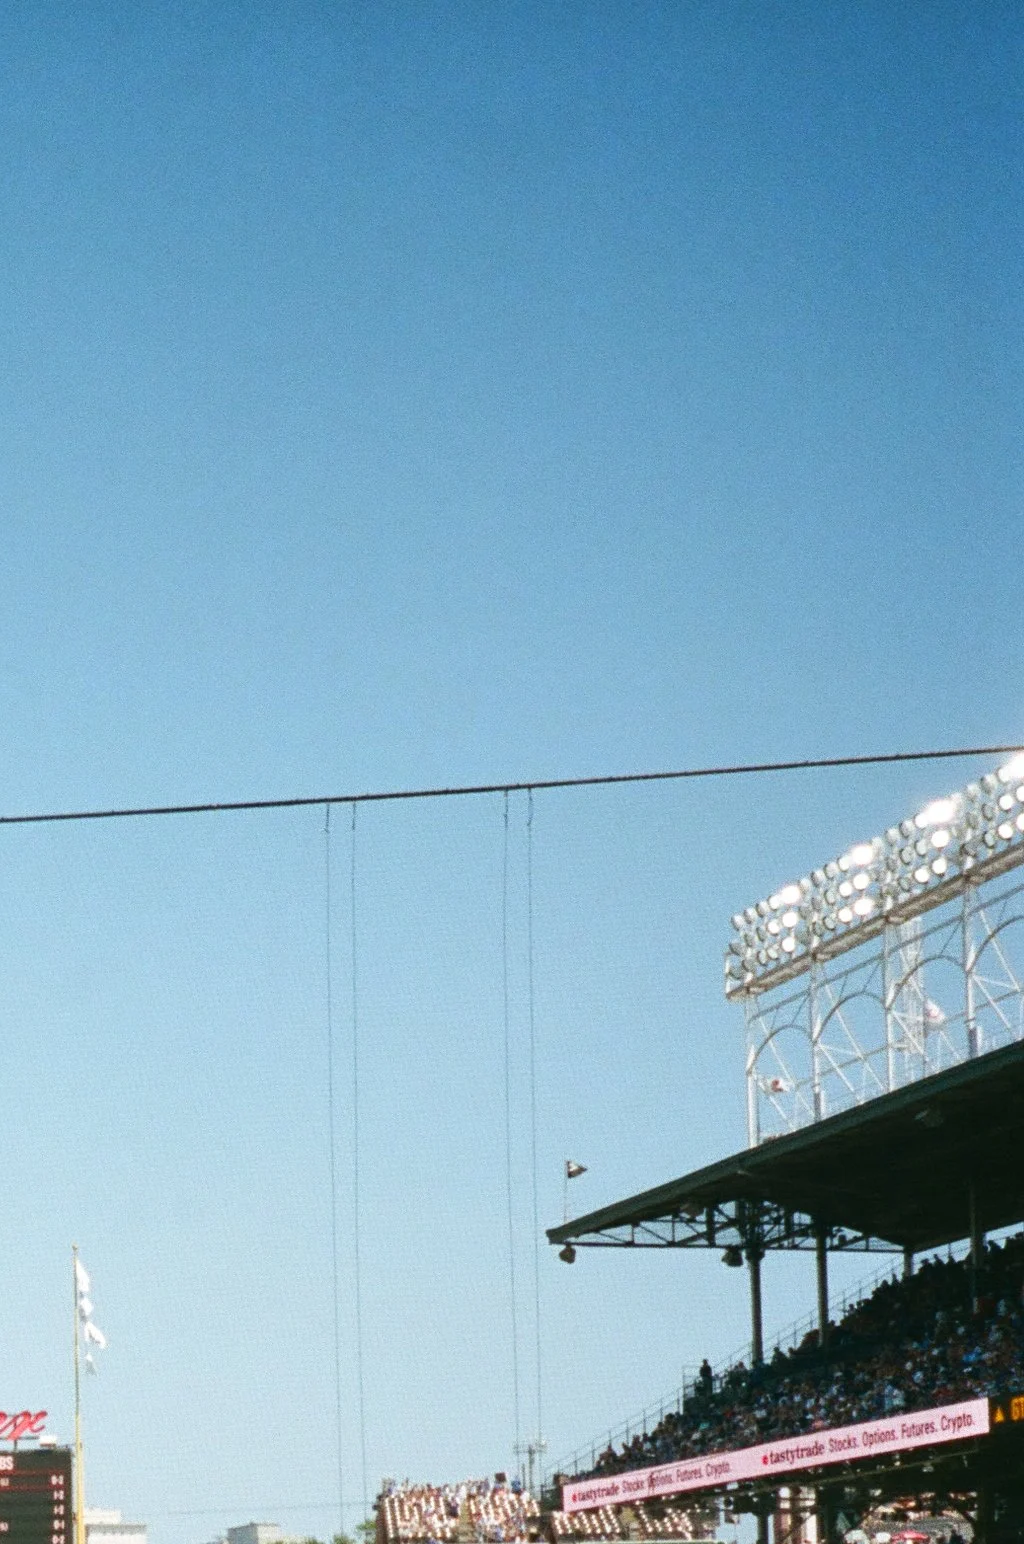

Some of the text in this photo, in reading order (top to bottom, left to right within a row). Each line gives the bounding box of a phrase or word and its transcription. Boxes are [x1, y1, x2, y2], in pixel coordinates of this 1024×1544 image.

[769, 1412, 975, 1465] tastytrade Stocks. Options. Futures. Crypto.
